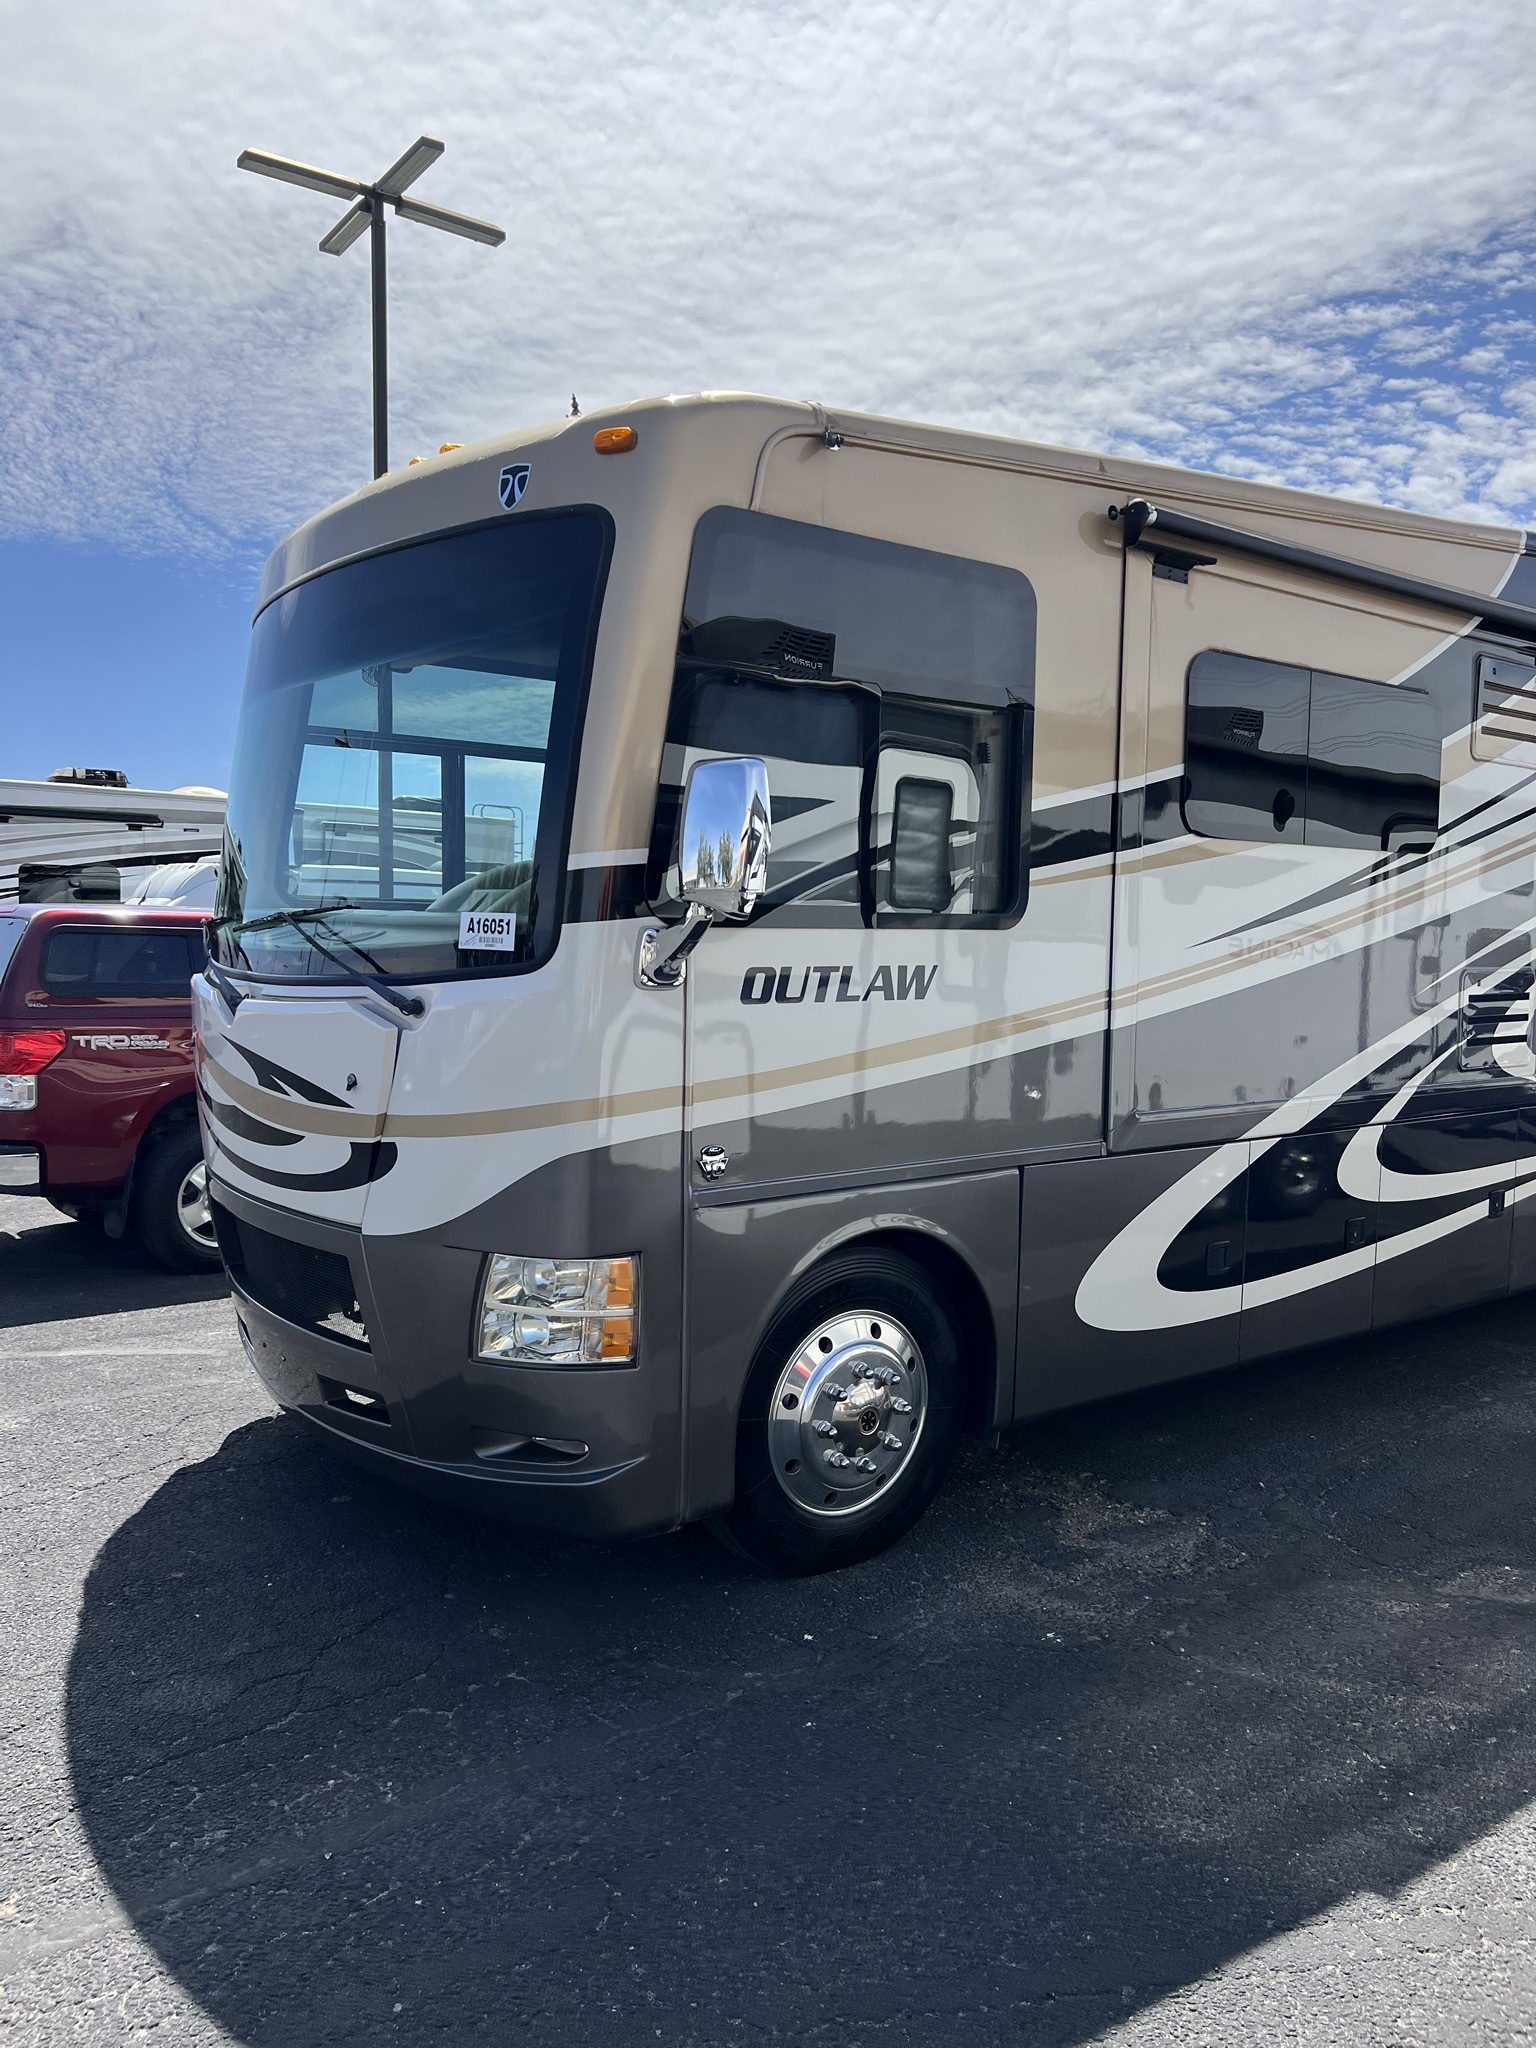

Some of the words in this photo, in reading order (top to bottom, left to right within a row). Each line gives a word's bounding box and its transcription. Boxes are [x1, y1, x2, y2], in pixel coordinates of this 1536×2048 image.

[467, 917, 511, 935] A16051
[740, 965, 939, 1005] OUTLAW
[72, 1035, 130, 1050] TRD
